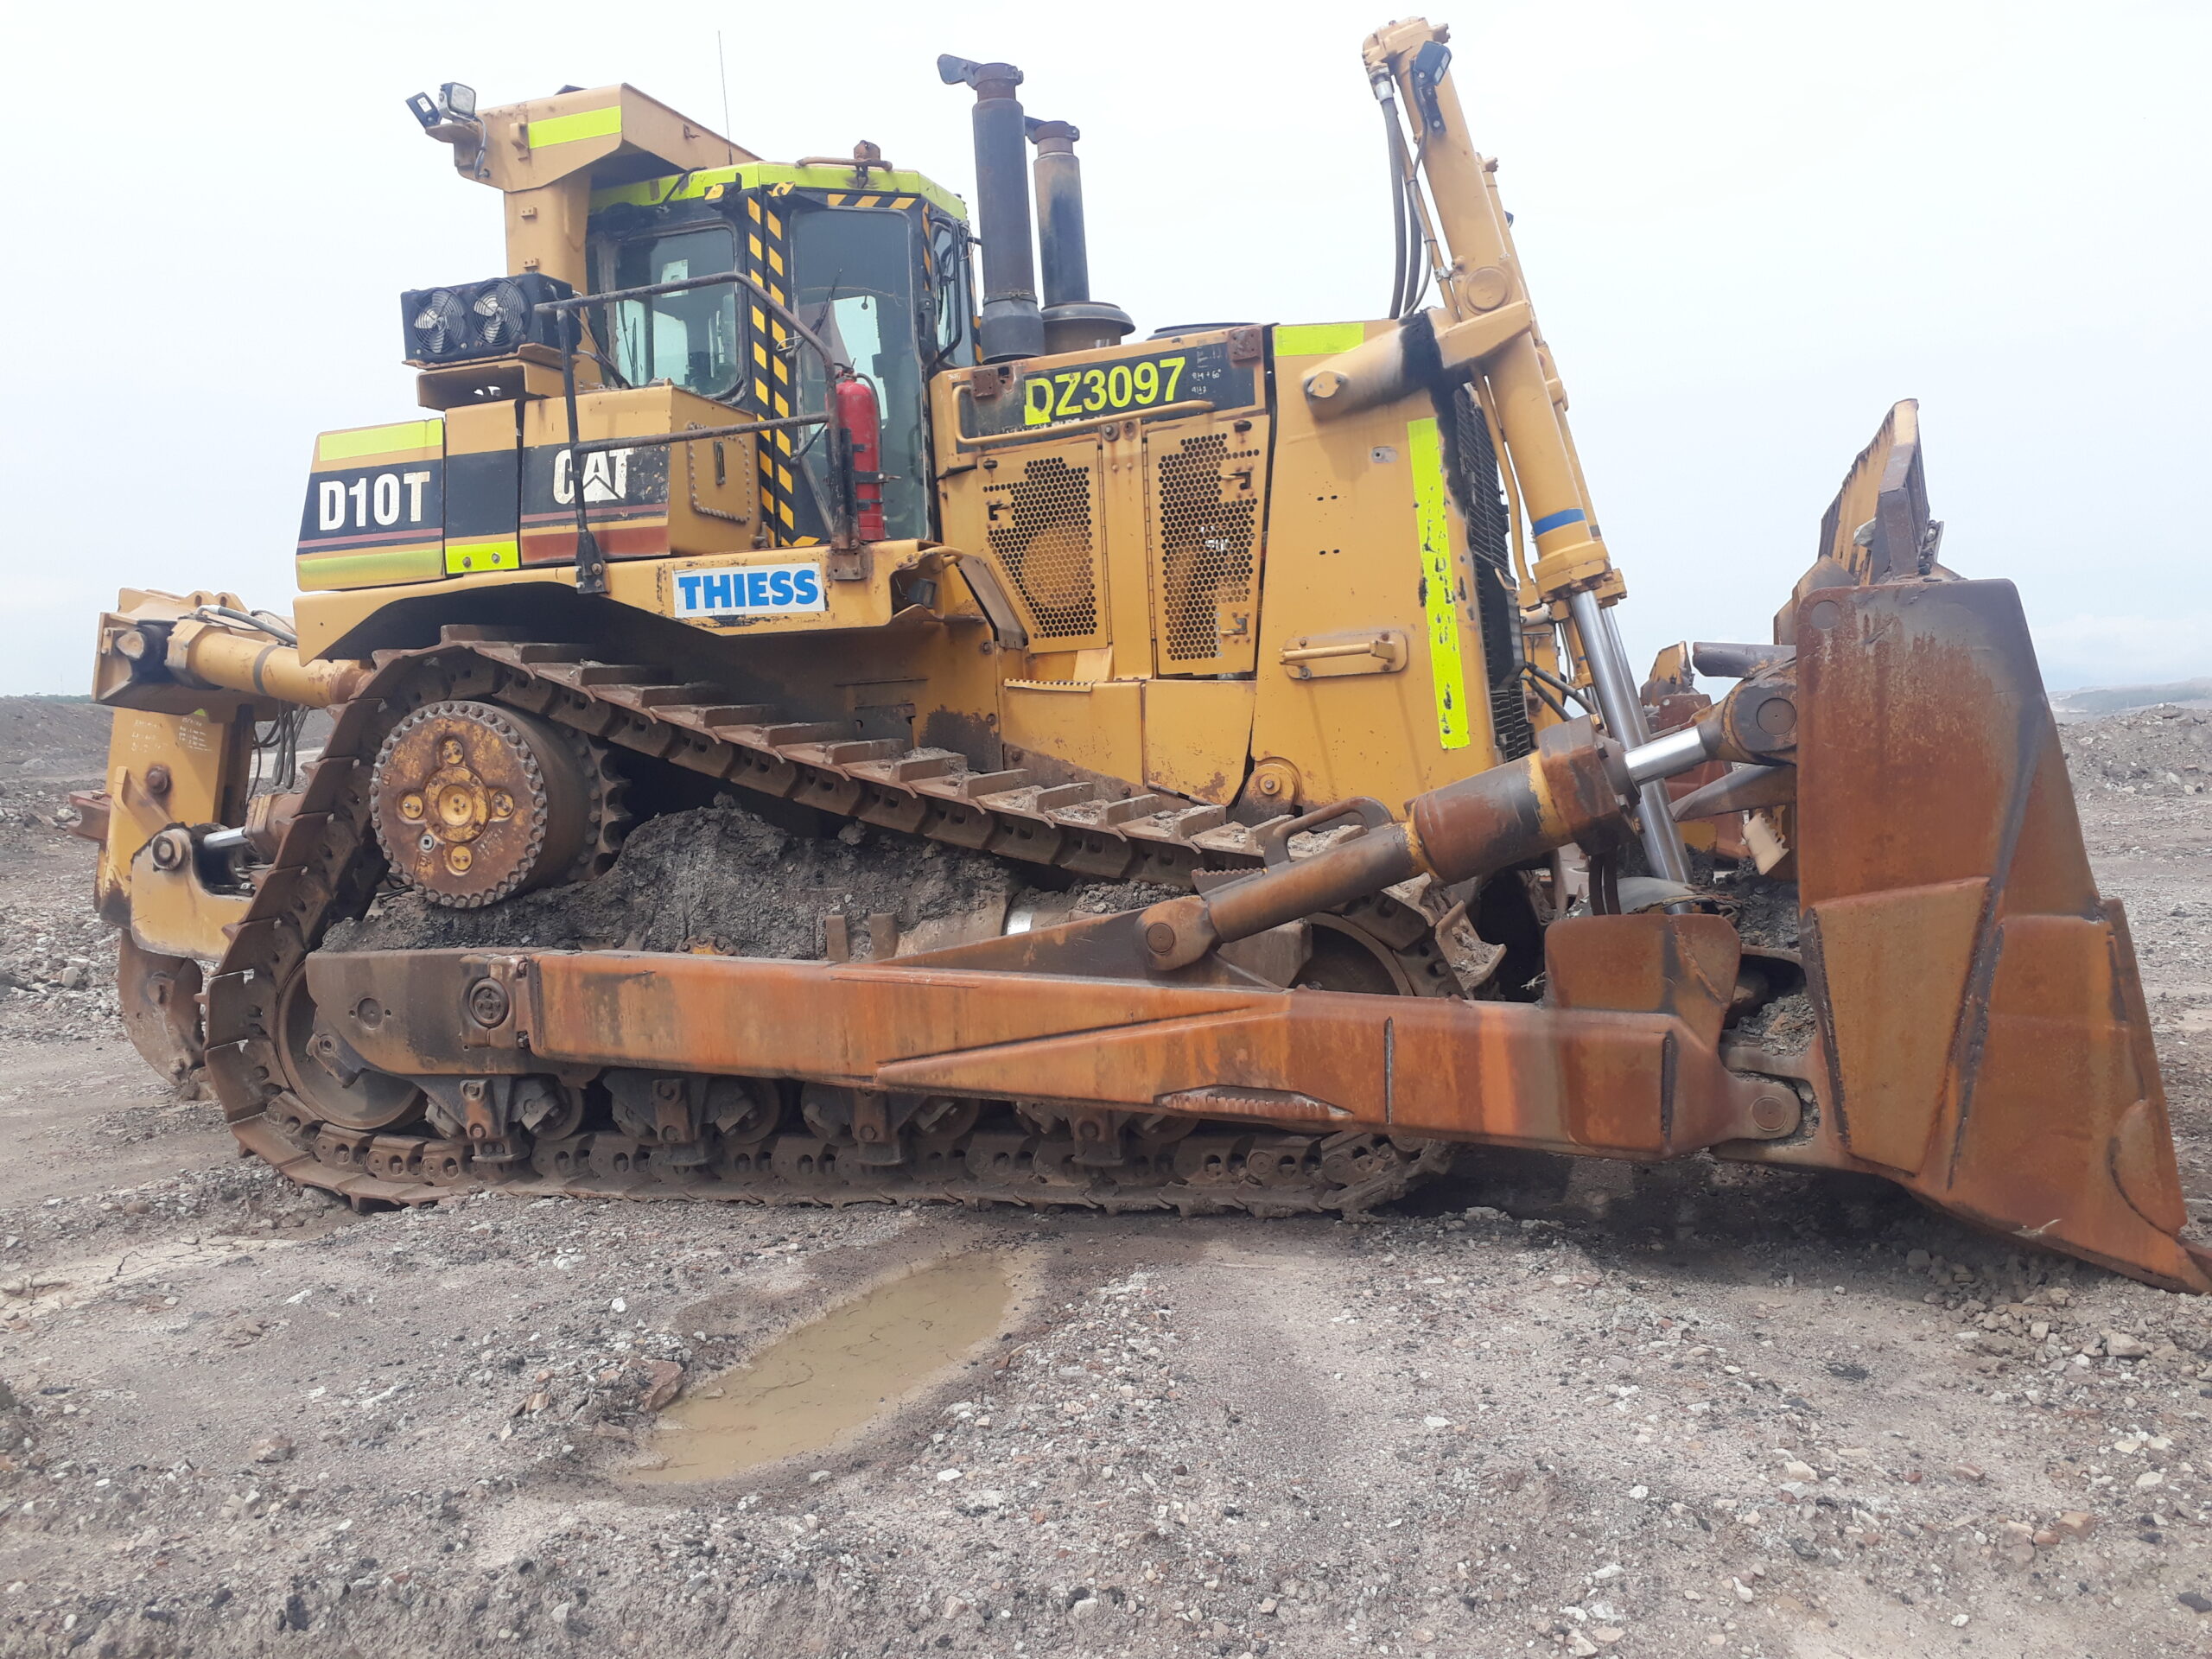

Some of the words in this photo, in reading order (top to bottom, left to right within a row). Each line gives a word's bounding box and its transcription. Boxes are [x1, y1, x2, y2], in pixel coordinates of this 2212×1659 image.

[1024, 357, 1185, 426] DZ3097
[319, 471, 430, 531] D10T
[553, 448, 633, 505] CAT
[678, 569, 819, 610] THIESS
